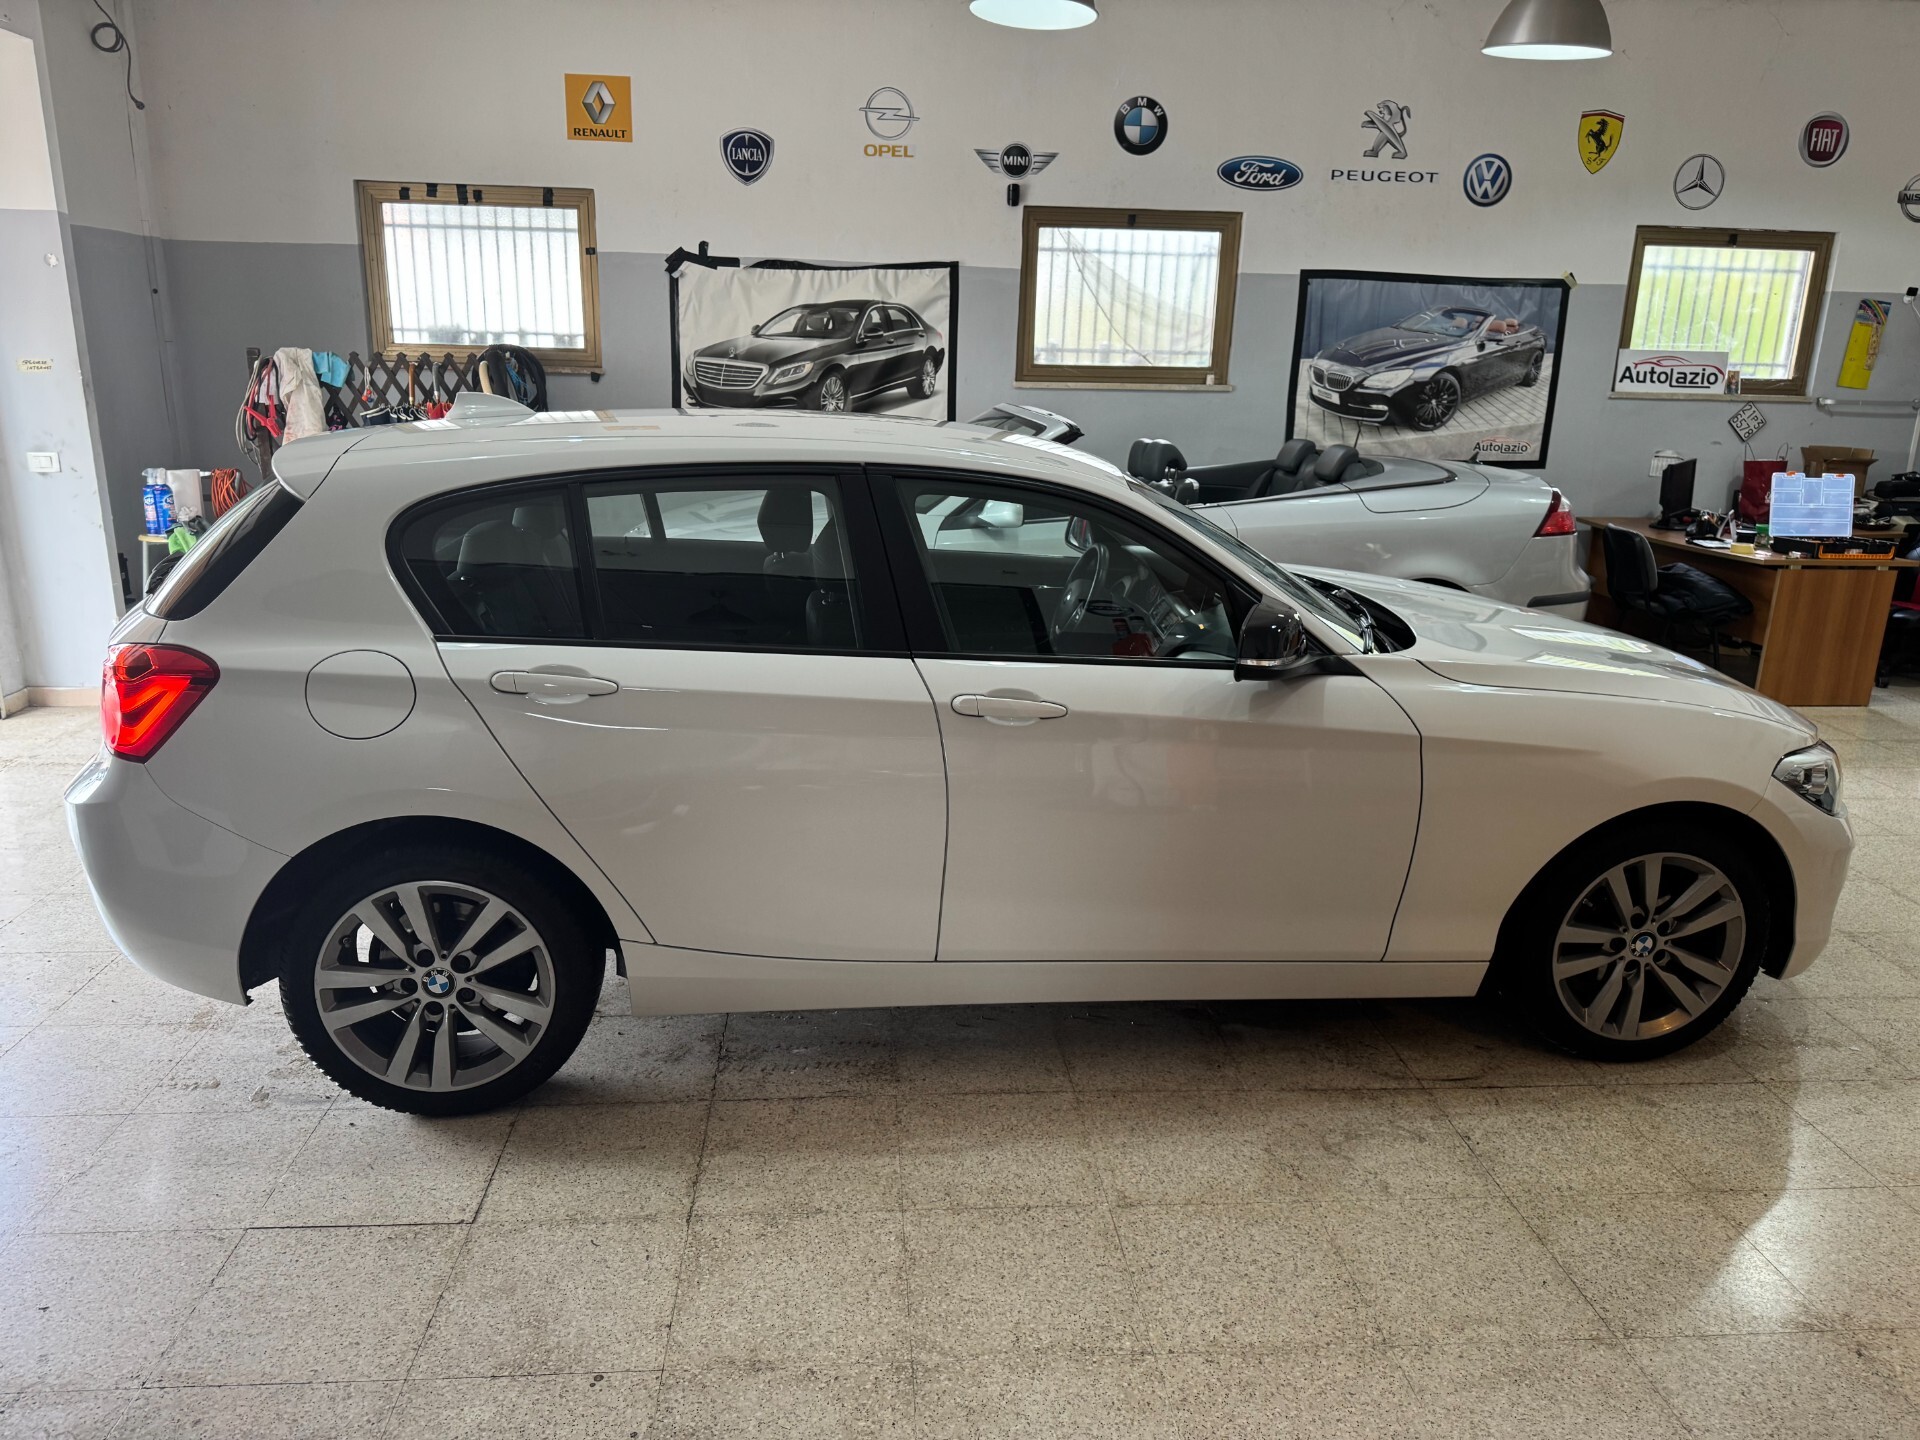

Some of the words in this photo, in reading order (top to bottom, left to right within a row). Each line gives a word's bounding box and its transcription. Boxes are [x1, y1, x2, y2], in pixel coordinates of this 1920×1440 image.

[1120, 97, 1164, 117] BMW
[573, 127, 627, 139] RENAULT
[1810, 128, 1840, 153] FIAT
[732, 147, 763, 162] LANCIA
[863, 144, 914, 158] OPEL
[1003, 155, 1029, 167] MINI
[1233, 161, 1286, 186] Ford
[1330, 169, 1439, 184] PEUGEOT
[1467, 158, 1506, 200] VW
[1732, 413, 1754, 439] 6578
[1741, 404, 1764, 430] 21P3
